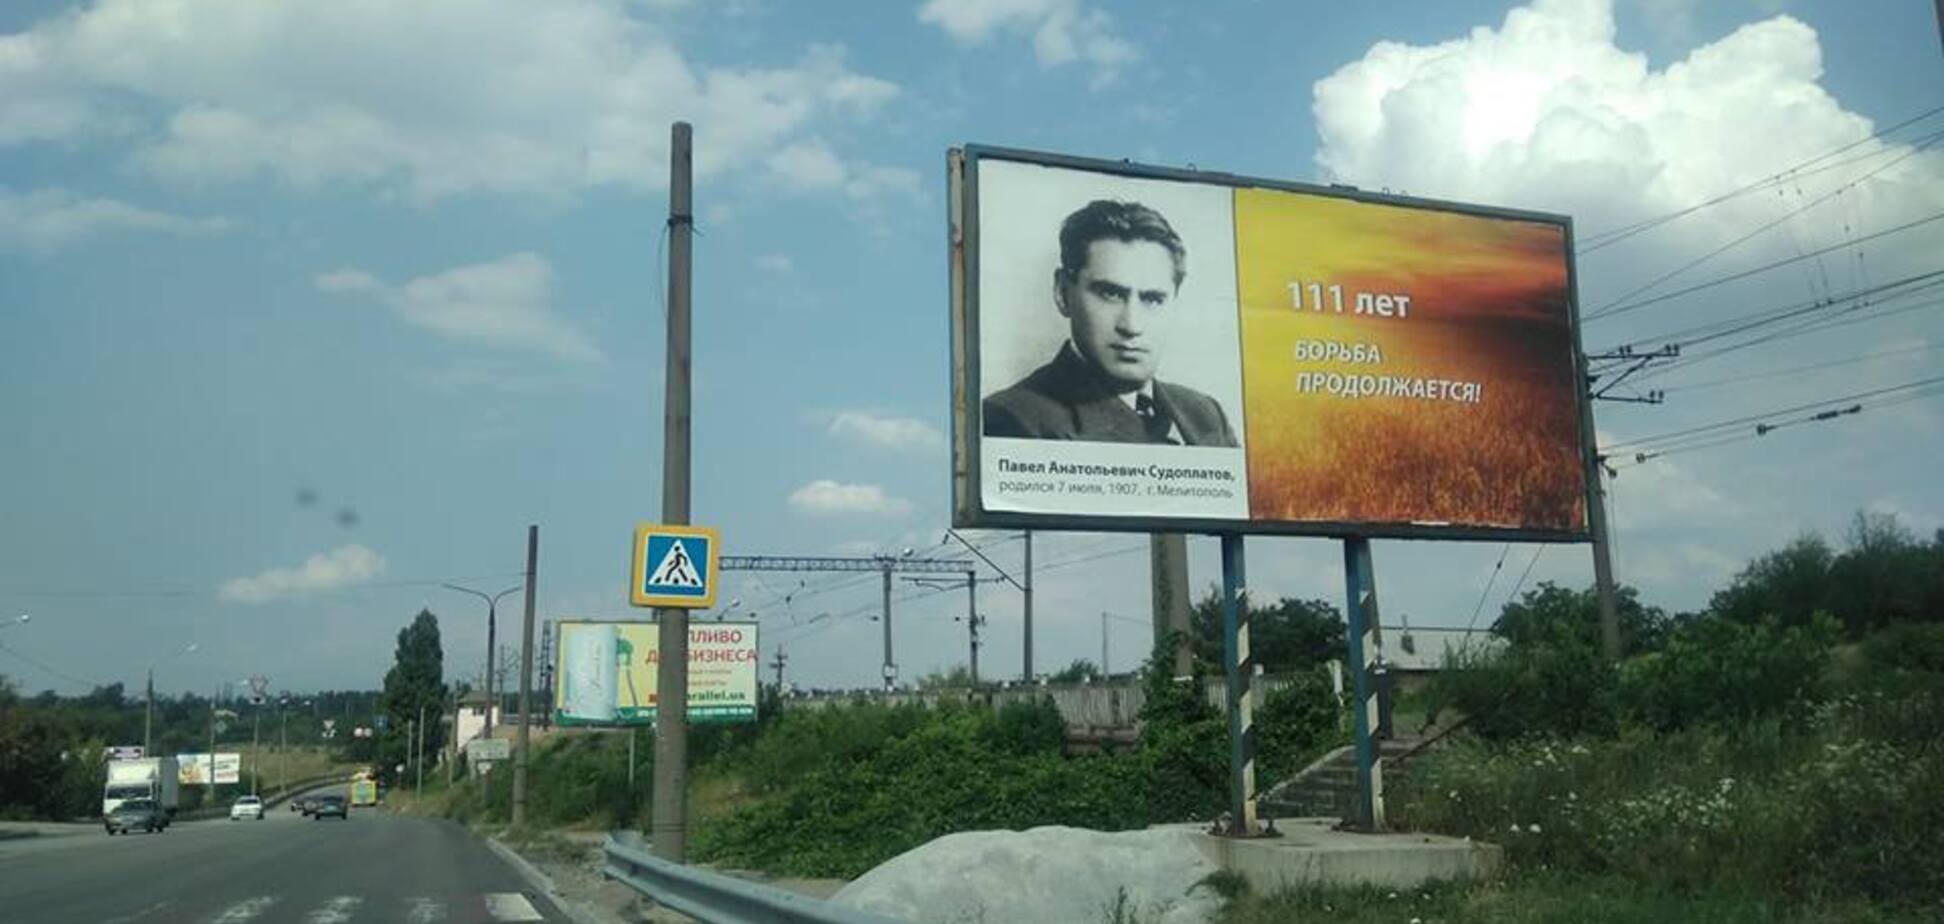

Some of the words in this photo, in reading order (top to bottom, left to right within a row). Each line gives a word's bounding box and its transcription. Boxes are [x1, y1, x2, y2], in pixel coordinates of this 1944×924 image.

[1287, 281, 1344, 313] 111
[1354, 293, 1411, 318] лет
[1295, 340, 1382, 364] БОРЬБА
[1295, 372, 1482, 403] ПРОДОЛЖАЕТСЯ!
[998, 459, 1045, 475] Павел
[1048, 461, 1145, 477] Анатольевич
[1149, 465, 1236, 482] Судоплатов,
[999, 481, 1054, 494] родился
[1057, 481, 1066, 493] 7
[1109, 483, 1141, 496] 1907,
[688, 629, 742, 644] ПЛИВО
[686, 690, 745, 701] arallel.ua
